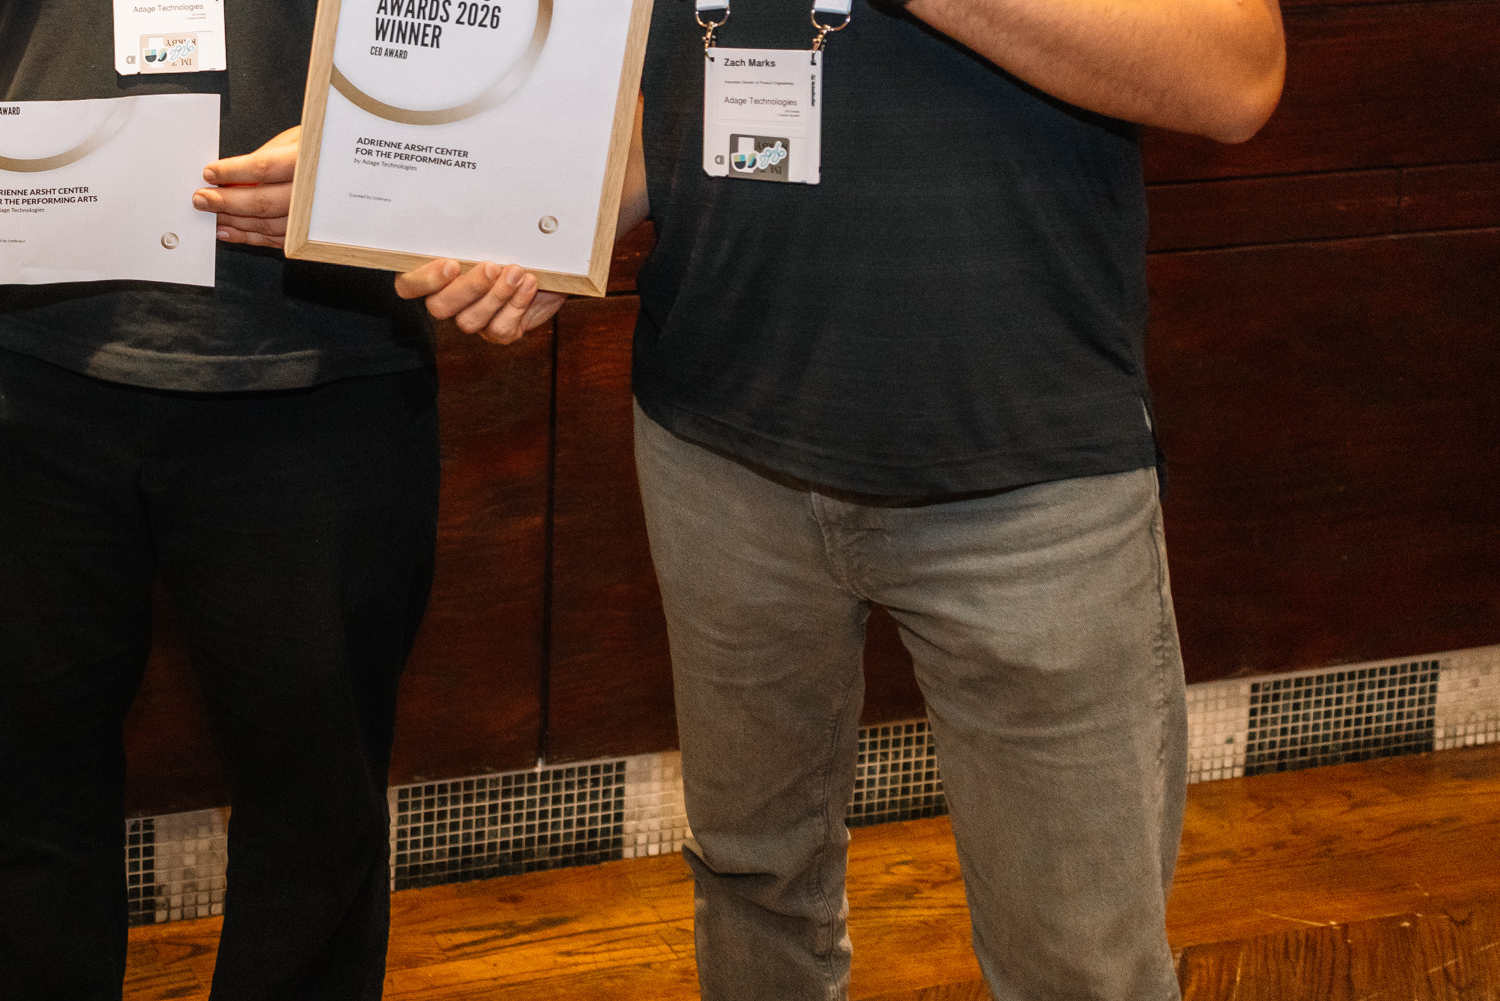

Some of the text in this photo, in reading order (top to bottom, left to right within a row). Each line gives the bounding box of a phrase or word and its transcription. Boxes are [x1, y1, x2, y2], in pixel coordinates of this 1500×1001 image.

[133, 3, 203, 14] Adage Technologies
[455, 1, 502, 29] 2026
[375, 17, 443, 49] WINNER
[370, 46, 408, 60] CEO AWARD
[724, 58, 776, 68] Zach Marks
[724, 97, 798, 107] Adage Technologies
[357, 137, 469, 158] ADRIENNE ARSHT CENTER
[355, 147, 477, 170] FOR THE PERFORMING ARTS
[362, 158, 380, 167] Adage
[381, 161, 417, 171] Technologies
[58, 186, 89, 195] CENTER
[22, 196, 76, 205] PERFORMING
[77, 195, 98, 203] ARTS
